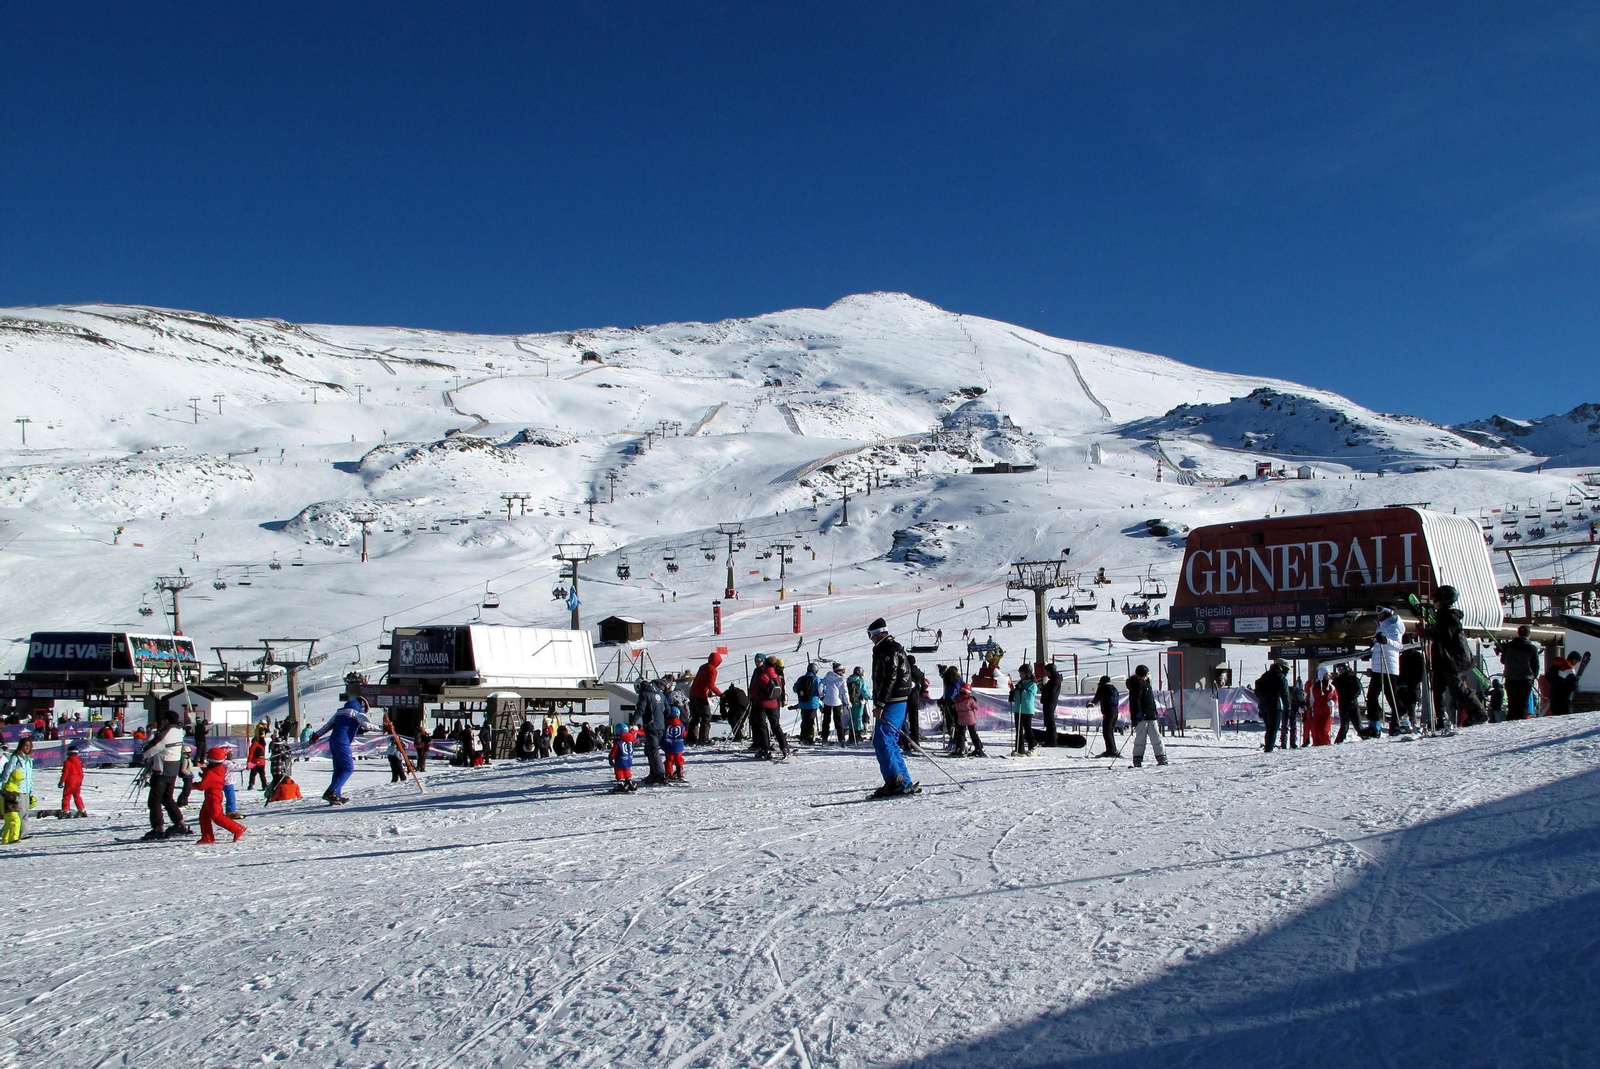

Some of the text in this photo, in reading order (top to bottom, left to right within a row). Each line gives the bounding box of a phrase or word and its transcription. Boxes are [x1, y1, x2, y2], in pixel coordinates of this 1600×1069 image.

[1185, 532, 1419, 597] GENERALI
[1194, 604, 1231, 617] Telesilla
[1232, 602, 1294, 618] Borreguiles
[29, 641, 98, 659] PULEVA
[414, 640, 430, 652] CAJA
[414, 652, 450, 664] GRANADA
[919, 709, 942, 723] sier
[1071, 707, 1101, 719] sierra
